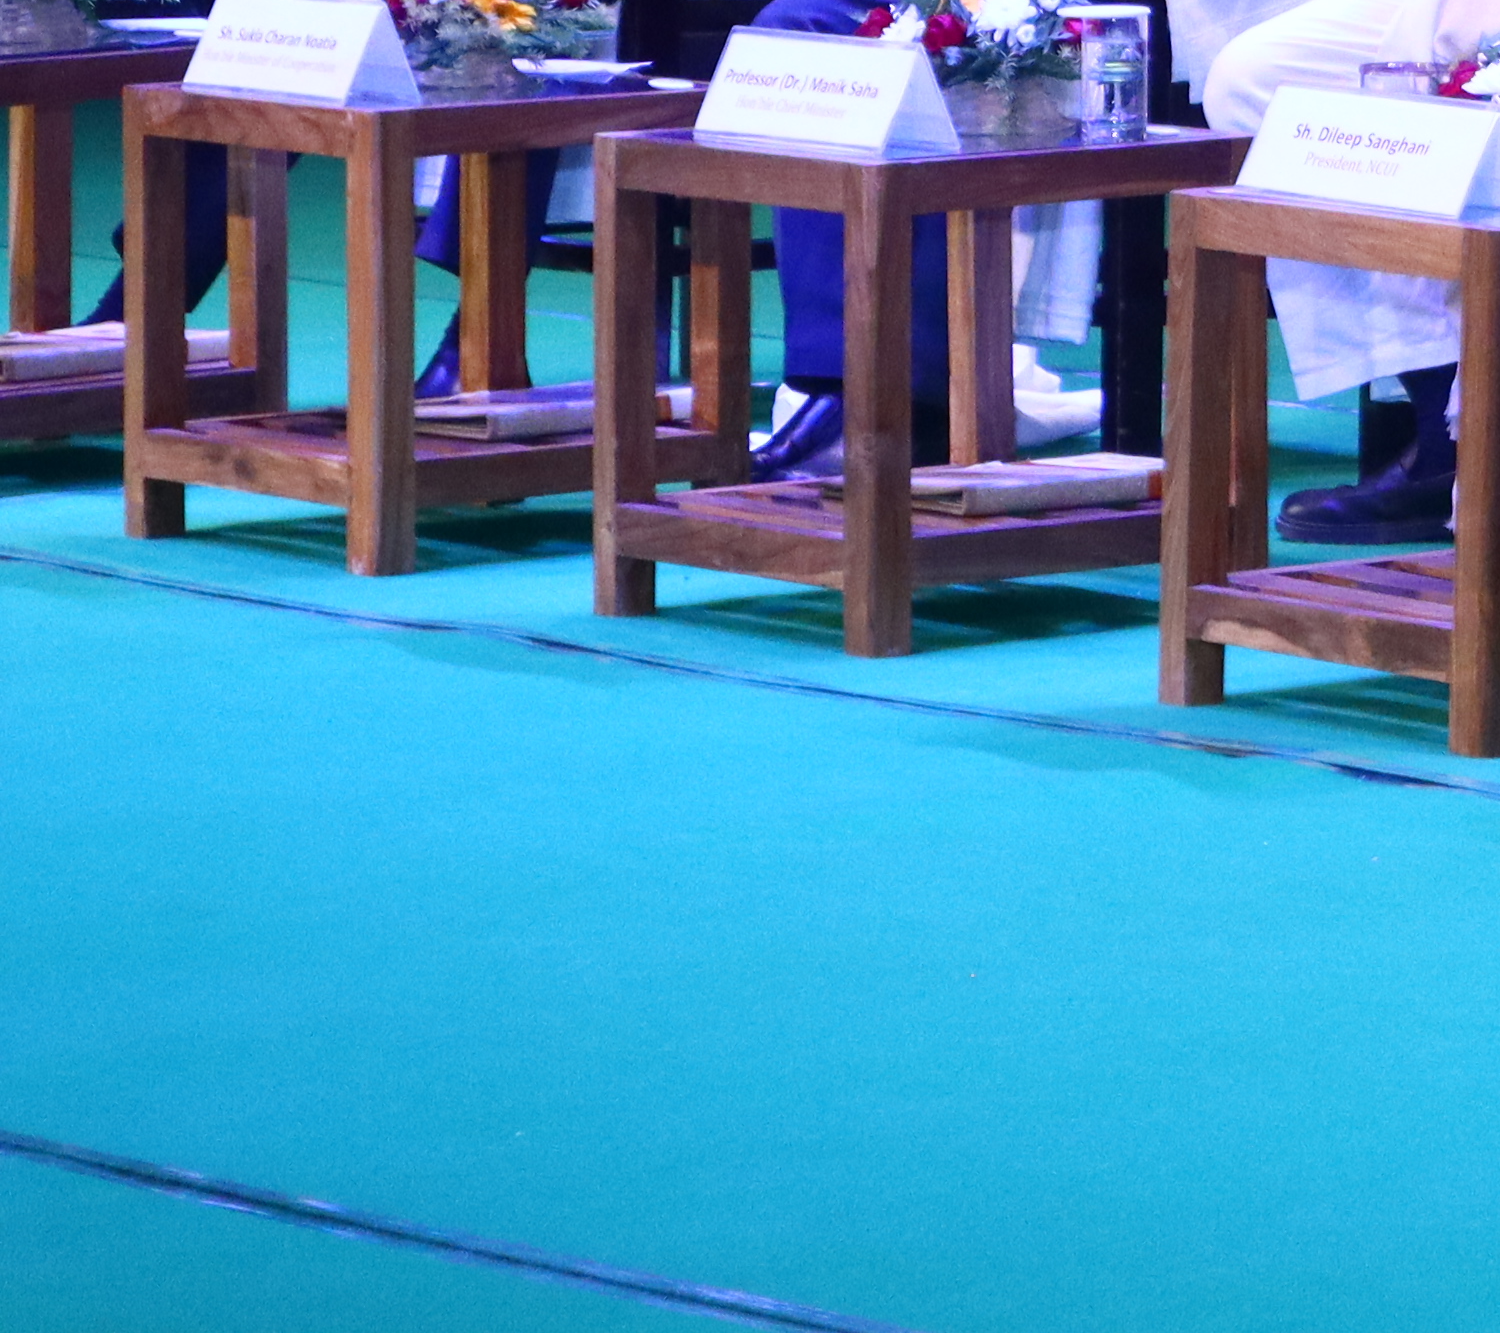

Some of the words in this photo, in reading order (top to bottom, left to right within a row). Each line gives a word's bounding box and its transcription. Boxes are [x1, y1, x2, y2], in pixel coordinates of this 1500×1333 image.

[724, 68, 778, 88] Professor
[810, 77, 846, 95] Manik
[847, 80, 879, 99] Saha
[1292, 122, 1313, 141] Sh.
[1316, 126, 1363, 151] Dileep
[1364, 132, 1433, 156] Sanghani
